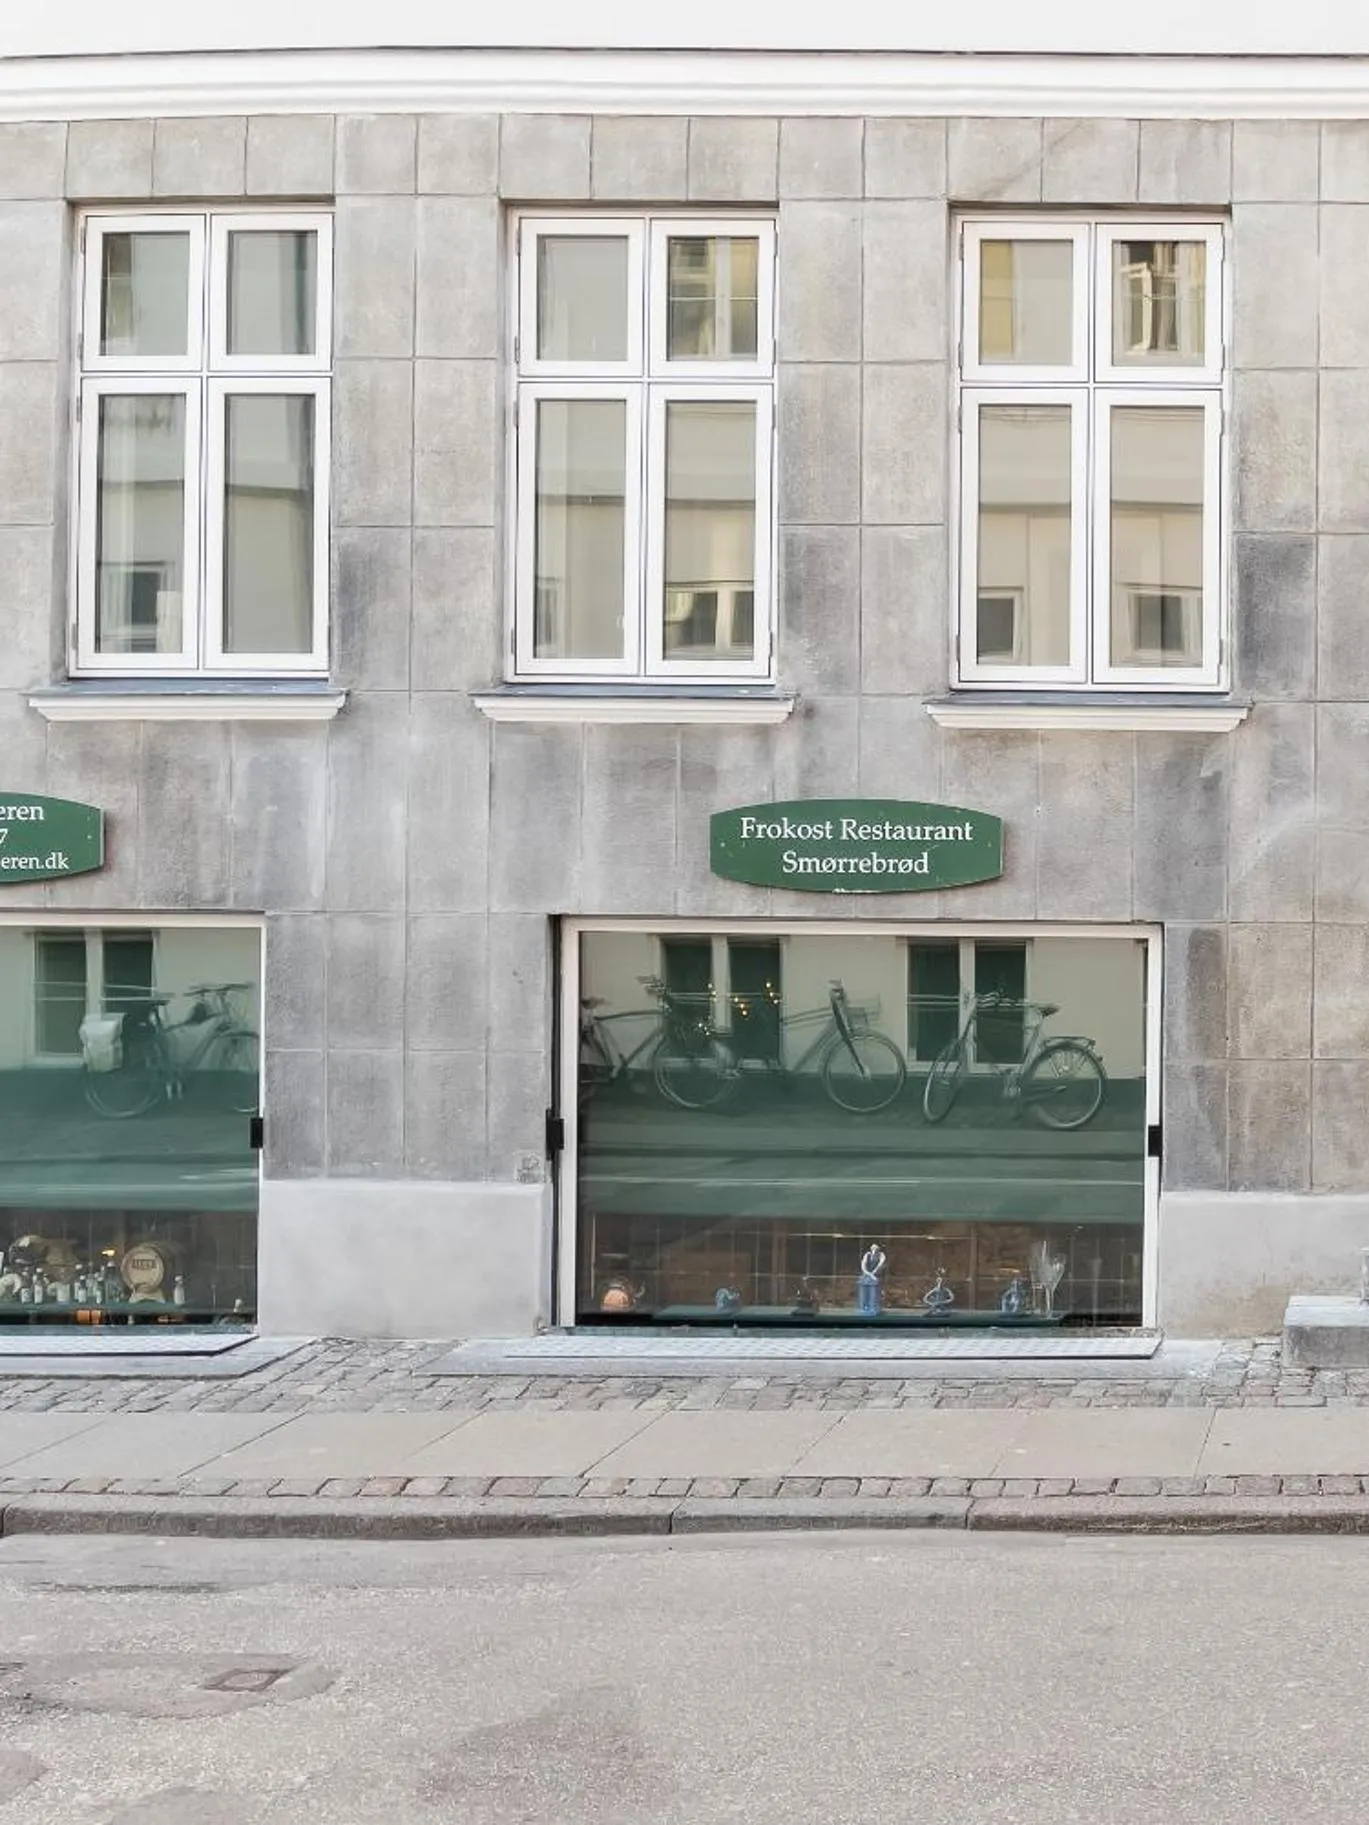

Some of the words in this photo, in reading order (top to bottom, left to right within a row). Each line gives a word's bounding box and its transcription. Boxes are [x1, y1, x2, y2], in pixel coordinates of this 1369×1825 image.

[740, 817, 833, 840] Frokost
[840, 819, 973, 841] Restaurant
[1, 851, 70, 870] eren.dk
[782, 850, 929, 874] Smørrebrød
